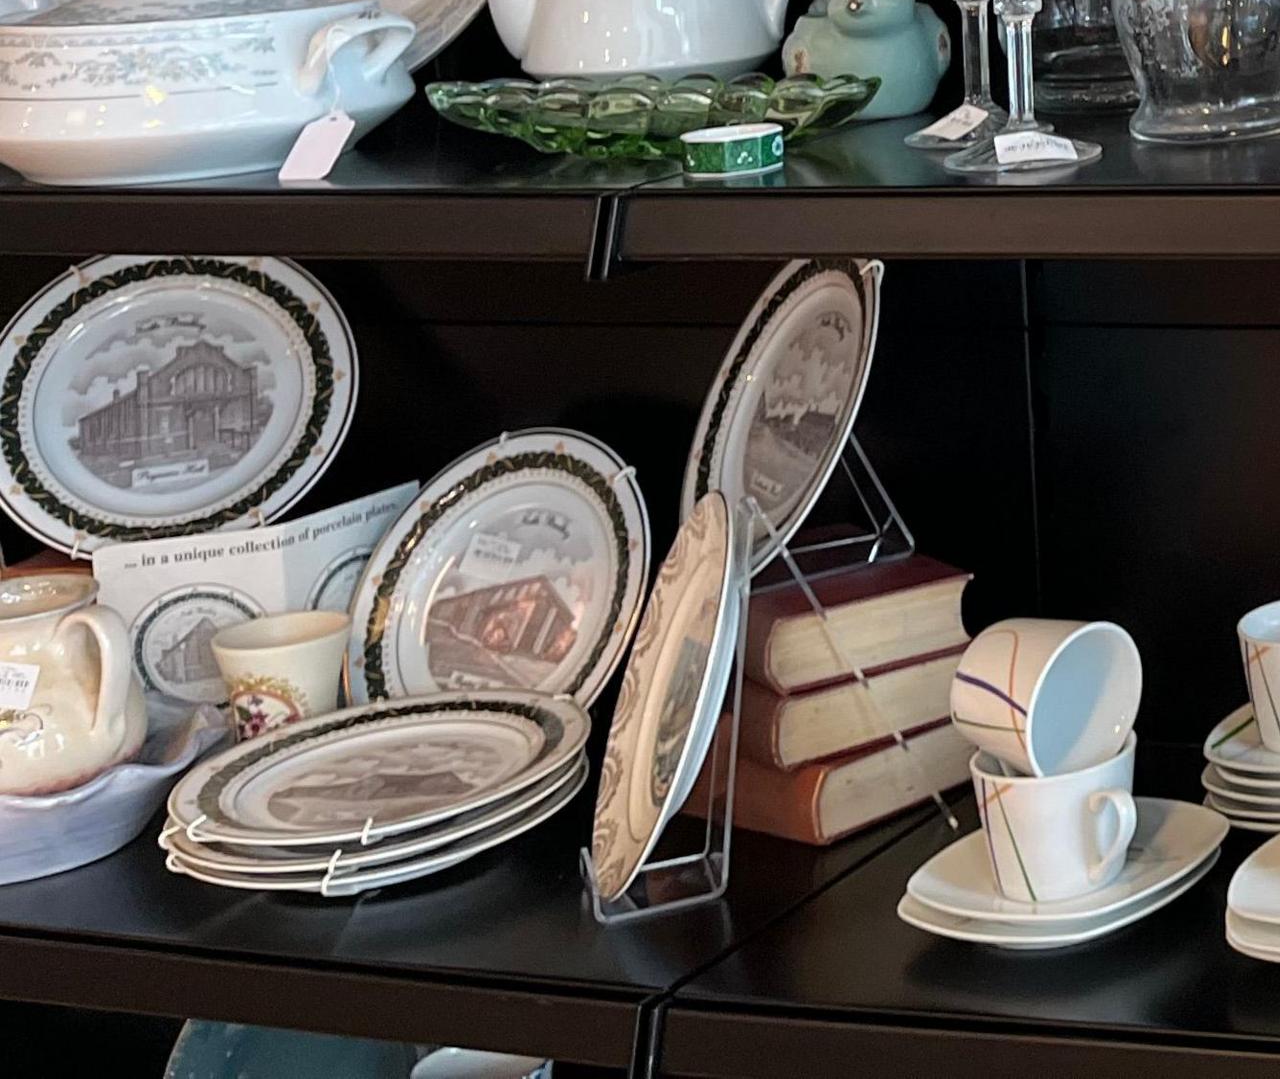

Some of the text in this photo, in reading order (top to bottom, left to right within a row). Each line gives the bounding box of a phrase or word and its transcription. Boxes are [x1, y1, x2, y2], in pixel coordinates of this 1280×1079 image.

[141, 553, 155, 567] in
[161, 555, 169, 565] a
[174, 548, 225, 563] unique
[229, 535, 295, 557] collection
[298, 527, 309, 543] of
[312, 514, 363, 541] porcelain
